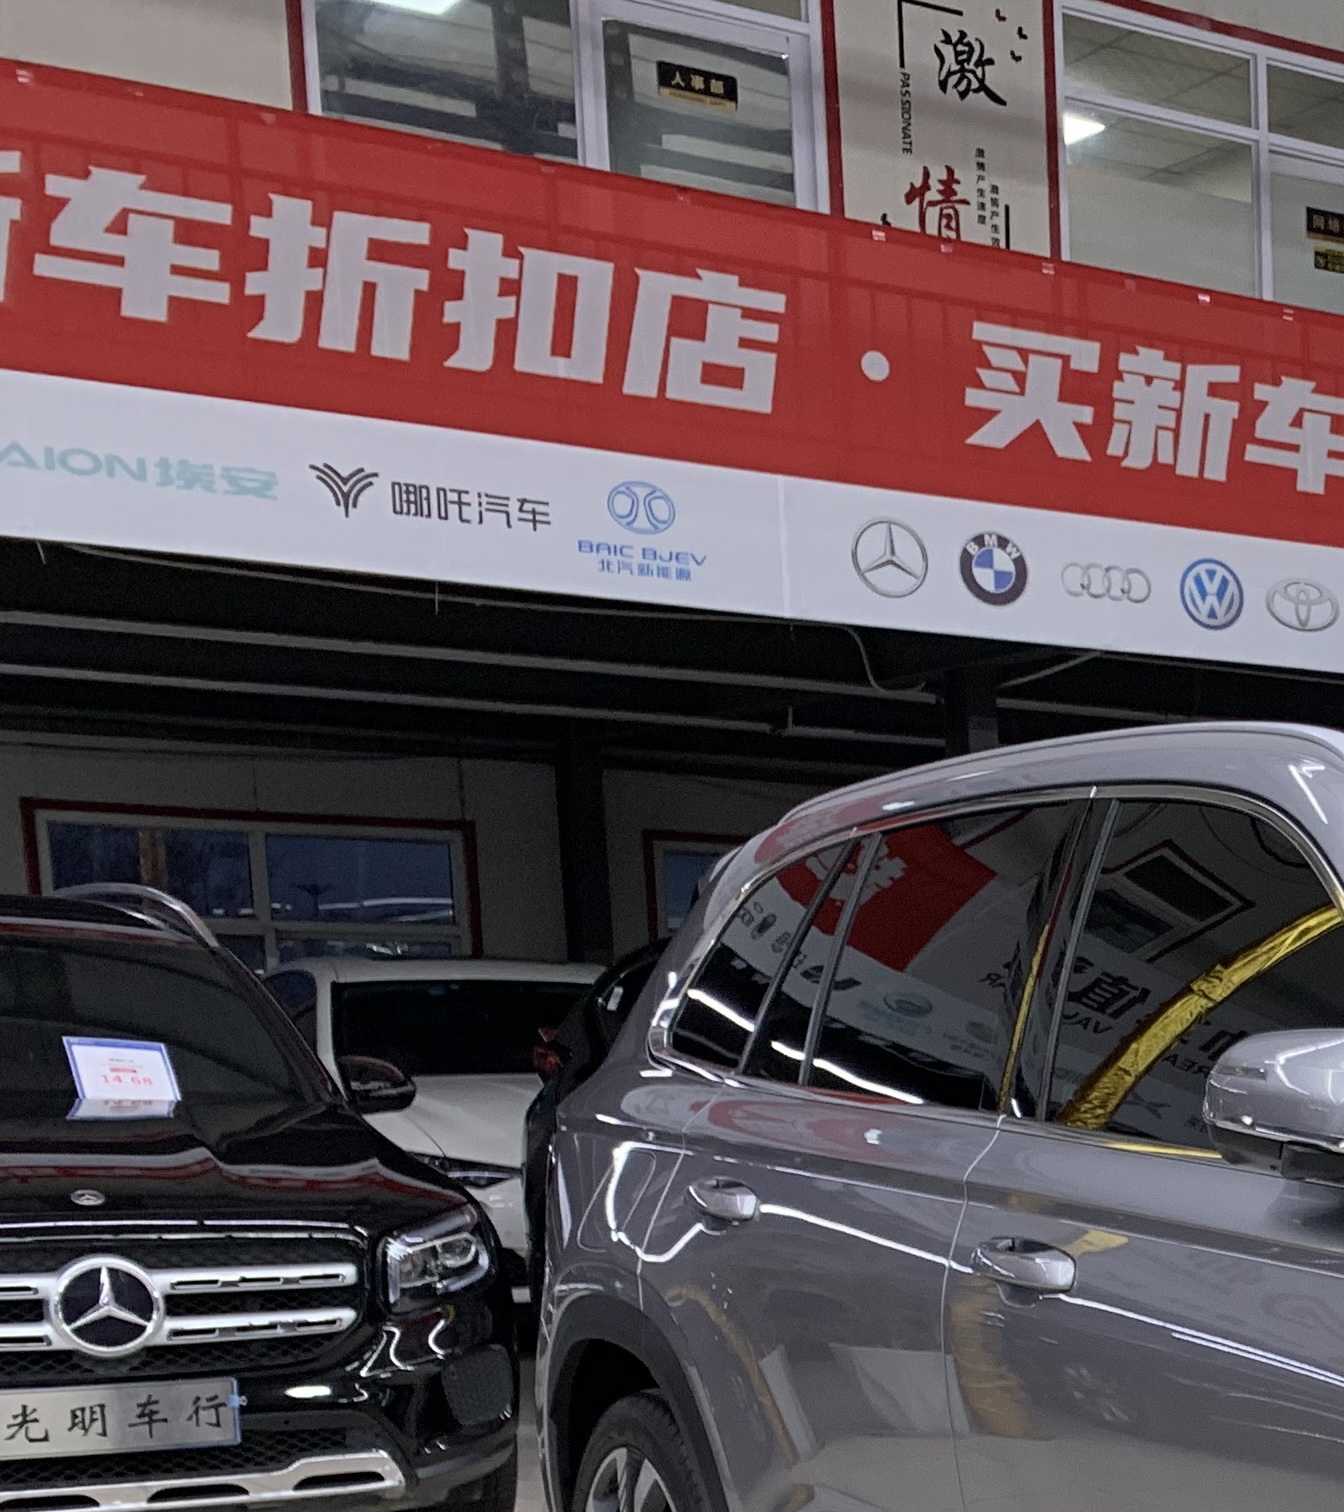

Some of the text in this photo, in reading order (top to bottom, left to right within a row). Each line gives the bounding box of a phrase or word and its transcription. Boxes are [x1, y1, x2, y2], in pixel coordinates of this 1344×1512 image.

[671, 71, 724, 95] 人事部
[933, 28, 1007, 107] 激
[900, 71, 913, 155] PASSIONATE
[904, 164, 971, 241] 情
[0, 150, 787, 413] 车折扣店
[0, 440, 147, 482] AION
[391, 479, 552, 532] 哪吒汽车
[577, 540, 707, 566] BAIC BJEV
[598, 558, 692, 582] 北汽新能源
[966, 532, 1022, 560] BMW
[4, 1393, 228, 1443] 光明车行
